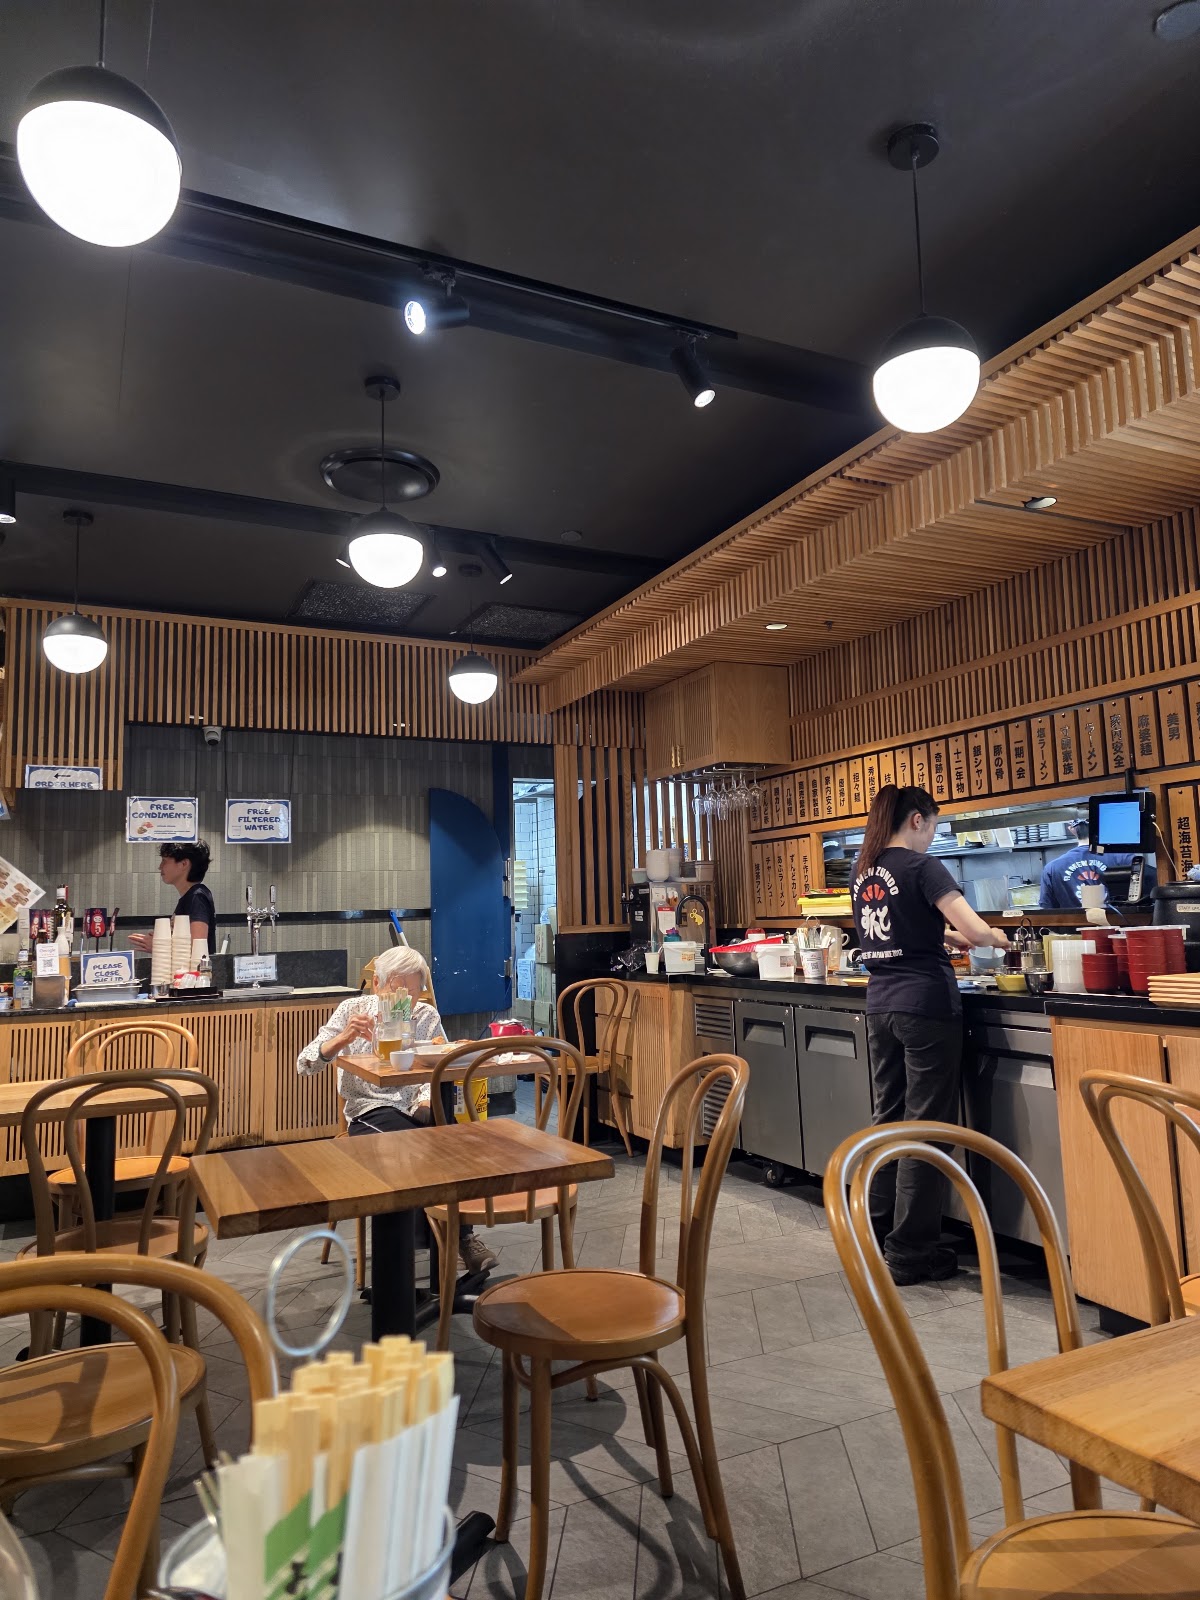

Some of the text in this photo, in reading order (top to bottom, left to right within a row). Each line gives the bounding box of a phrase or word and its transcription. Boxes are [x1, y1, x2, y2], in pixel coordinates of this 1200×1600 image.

[1109, 714, 1125, 769] 家内安全
[1137, 714, 1153, 757] 麻婆麺
[1167, 712, 1181, 742] 美男
[993, 744, 1005, 780] 豚の骨
[1013, 740, 1026, 780] 一期一会
[1037, 727, 1049, 781] 塩ラーメン
[1060, 726, 1074, 775] 寸胴家族
[1085, 723, 1098, 772] ラーメン
[68, 781, 94, 789] HERE
[935, 752, 945, 795] 奇跡の味
[953, 749, 965, 794] 十二年物
[973, 745, 983, 791] 銀シャリ
[131, 811, 193, 819] CONDIMENTS
[149, 803, 175, 811] FREE
[824, 776, 833, 815] 家内安全
[754, 863, 762, 904] 抹茶アイス
[765, 857, 773, 907] チャーシュー
[802, 855, 811, 892] 手作り餃
[875, 866, 900, 896] ZUNDO
[1063, 860, 1089, 882] RAMEN
[94, 922, 102, 934] 5
[92, 962, 123, 971] PLEASE
[94, 969, 122, 978] CLOSE
